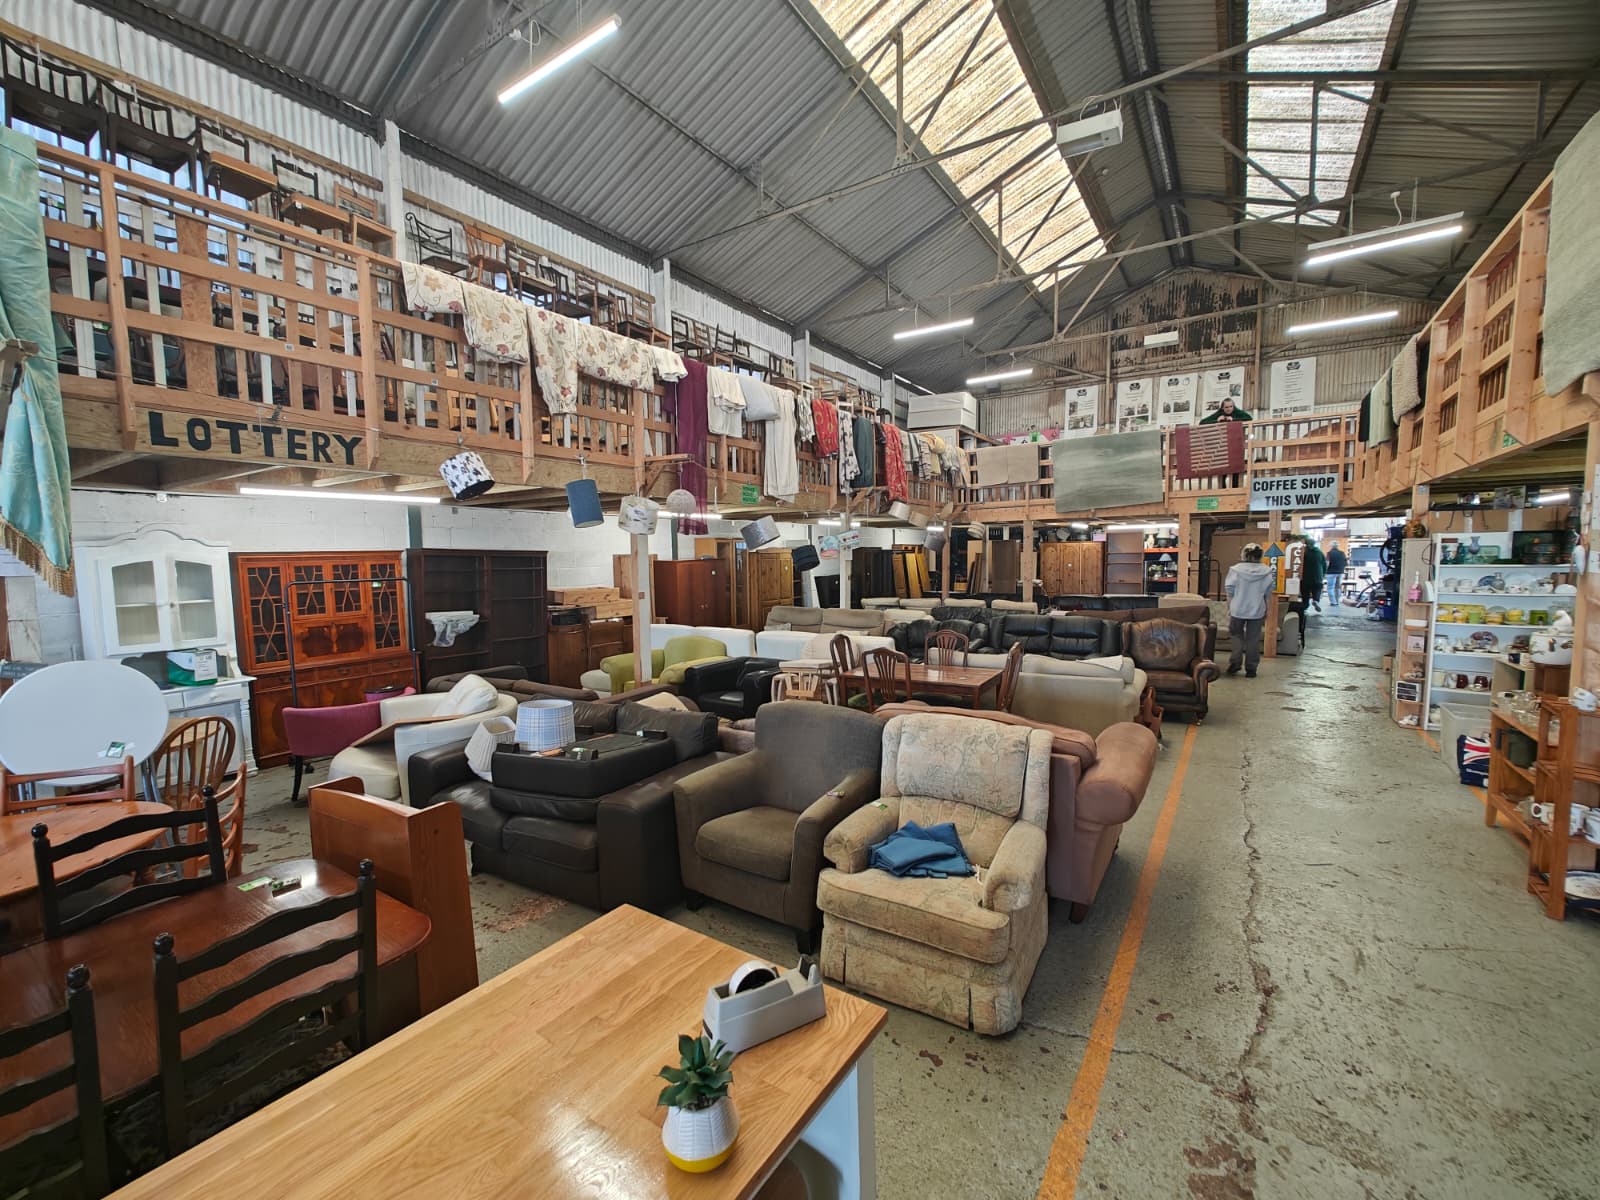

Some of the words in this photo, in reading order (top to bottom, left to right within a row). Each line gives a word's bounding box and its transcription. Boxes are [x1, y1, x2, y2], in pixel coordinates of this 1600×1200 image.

[148, 411, 363, 466] LOTTERY
[1253, 479, 1298, 492] COFFEE
[1301, 477, 1335, 489] SHOP
[1265, 495, 1291, 506] THIS
[1295, 494, 1320, 504] WAY
